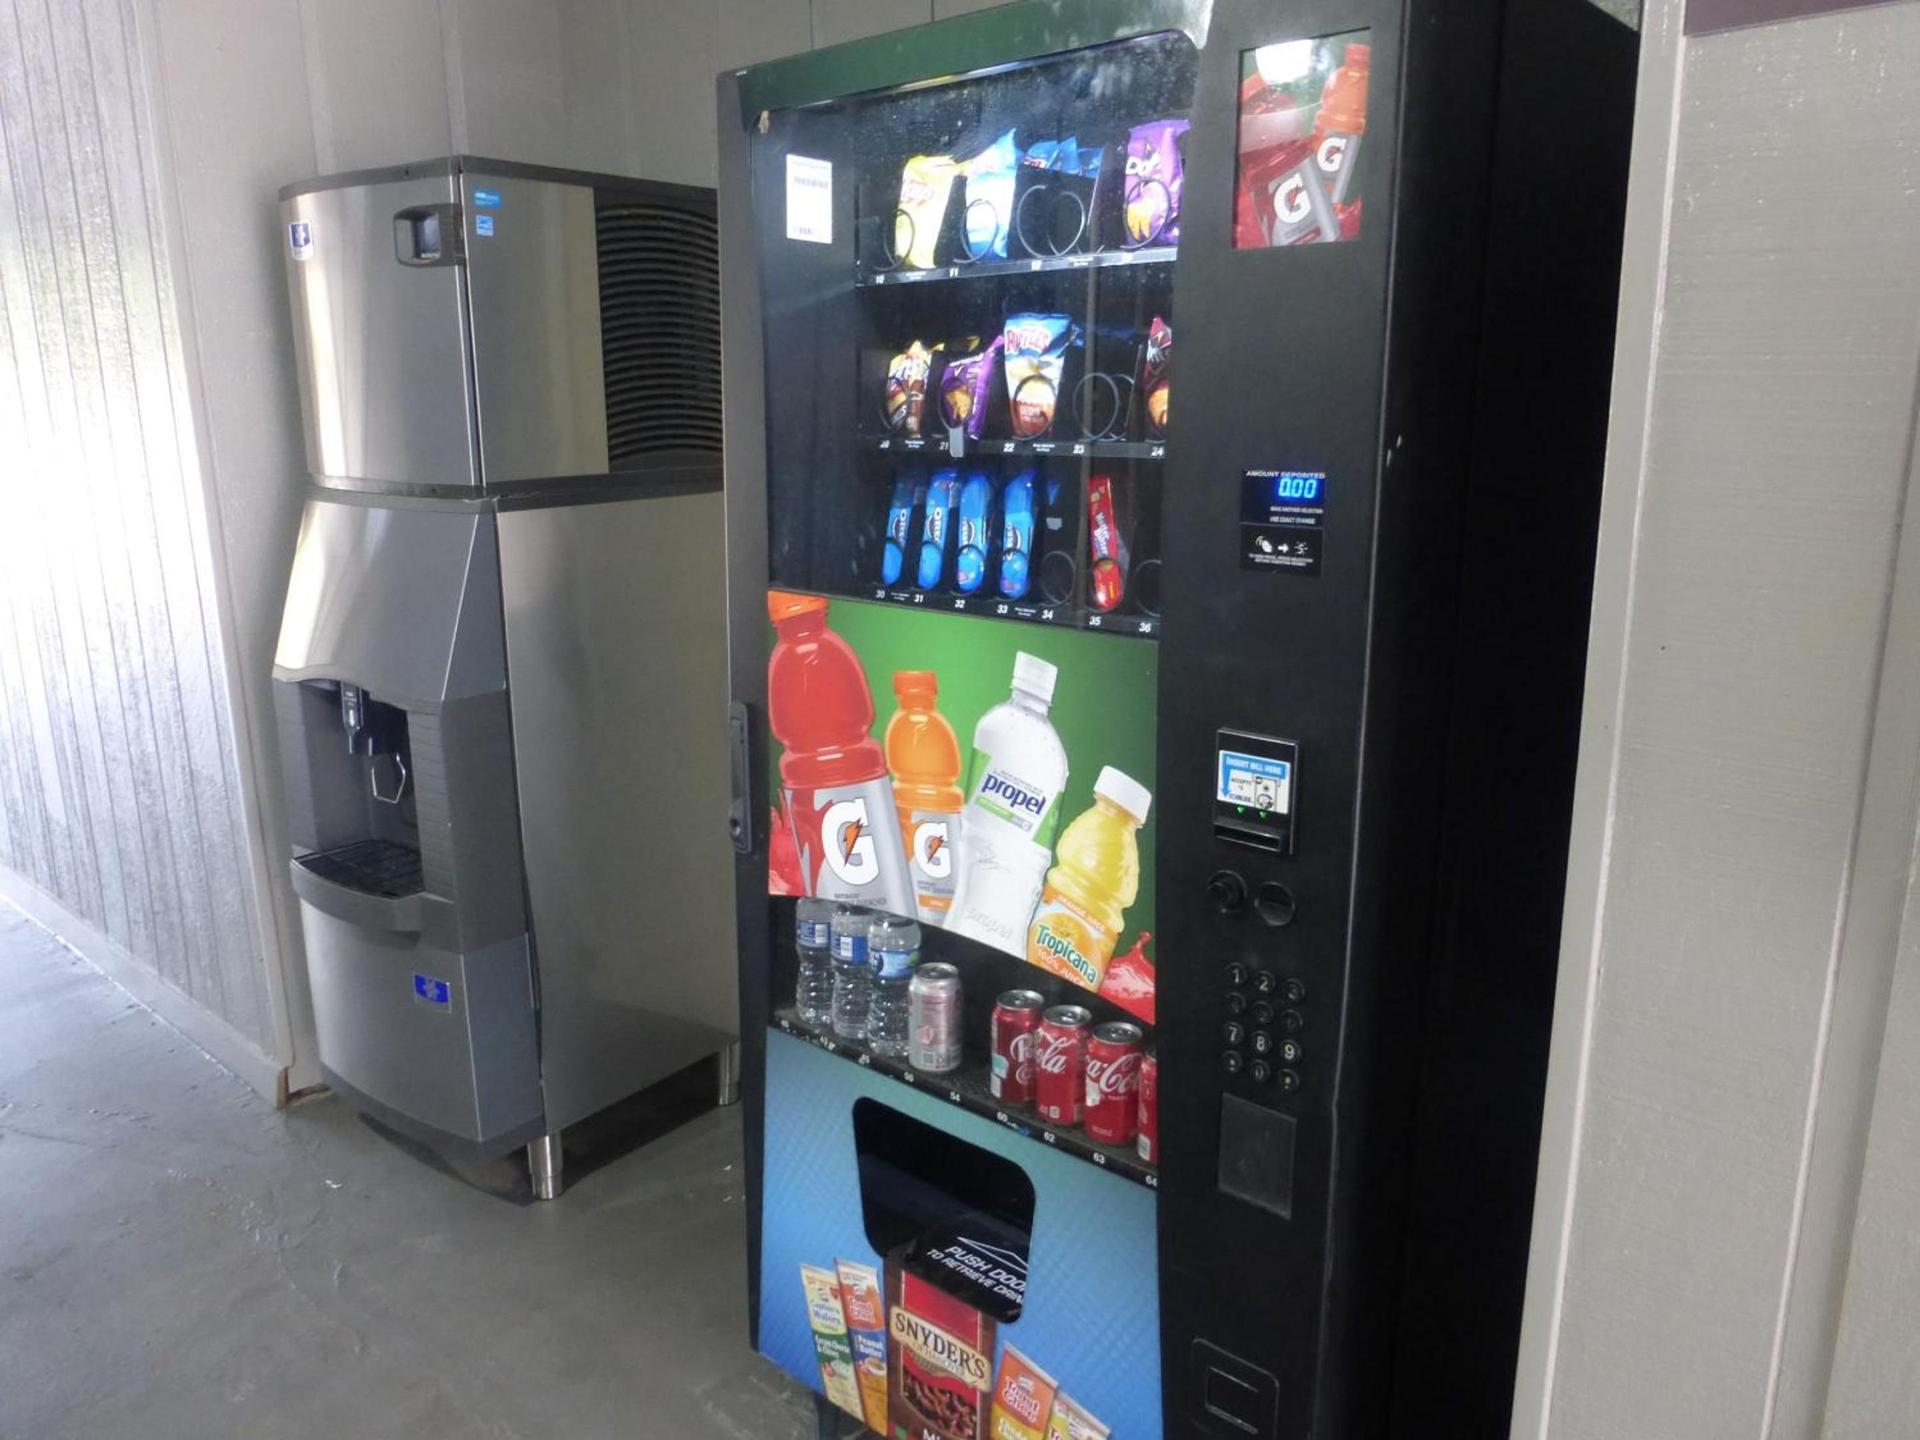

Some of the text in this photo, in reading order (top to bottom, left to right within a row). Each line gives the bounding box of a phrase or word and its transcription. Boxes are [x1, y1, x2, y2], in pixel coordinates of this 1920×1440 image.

[1317, 137, 1347, 172] G
[1273, 172, 1312, 224] G
[1003, 441, 1015, 453] 22
[1151, 446, 1164, 457] 24
[1245, 470, 1326, 479] AMOUNT DEPOSITED
[876, 589, 886, 599] 30
[914, 594, 924, 604] 31
[954, 599, 966, 609] 32
[996, 604, 1008, 614] 33
[1041, 609, 1053, 620] 34
[1089, 615, 1101, 626] 35
[1138, 621, 1151, 633] 36
[981, 773, 1047, 815] propel
[821, 797, 880, 886] G
[913, 821, 951, 878] G
[1036, 923, 1097, 984] Tropicana
[1256, 1035, 1266, 1052] 8
[1284, 1044, 1295, 1060] 9
[1044, 1131, 1056, 1143] 62
[1093, 1152, 1105, 1164] 63
[1145, 1175, 1157, 1187] 64
[927, 1249, 1024, 1304] TO RETRIEVE DRIN
[945, 1246, 1027, 1292] PUSH DOO
[895, 1313, 986, 1379] SNYDER'S
